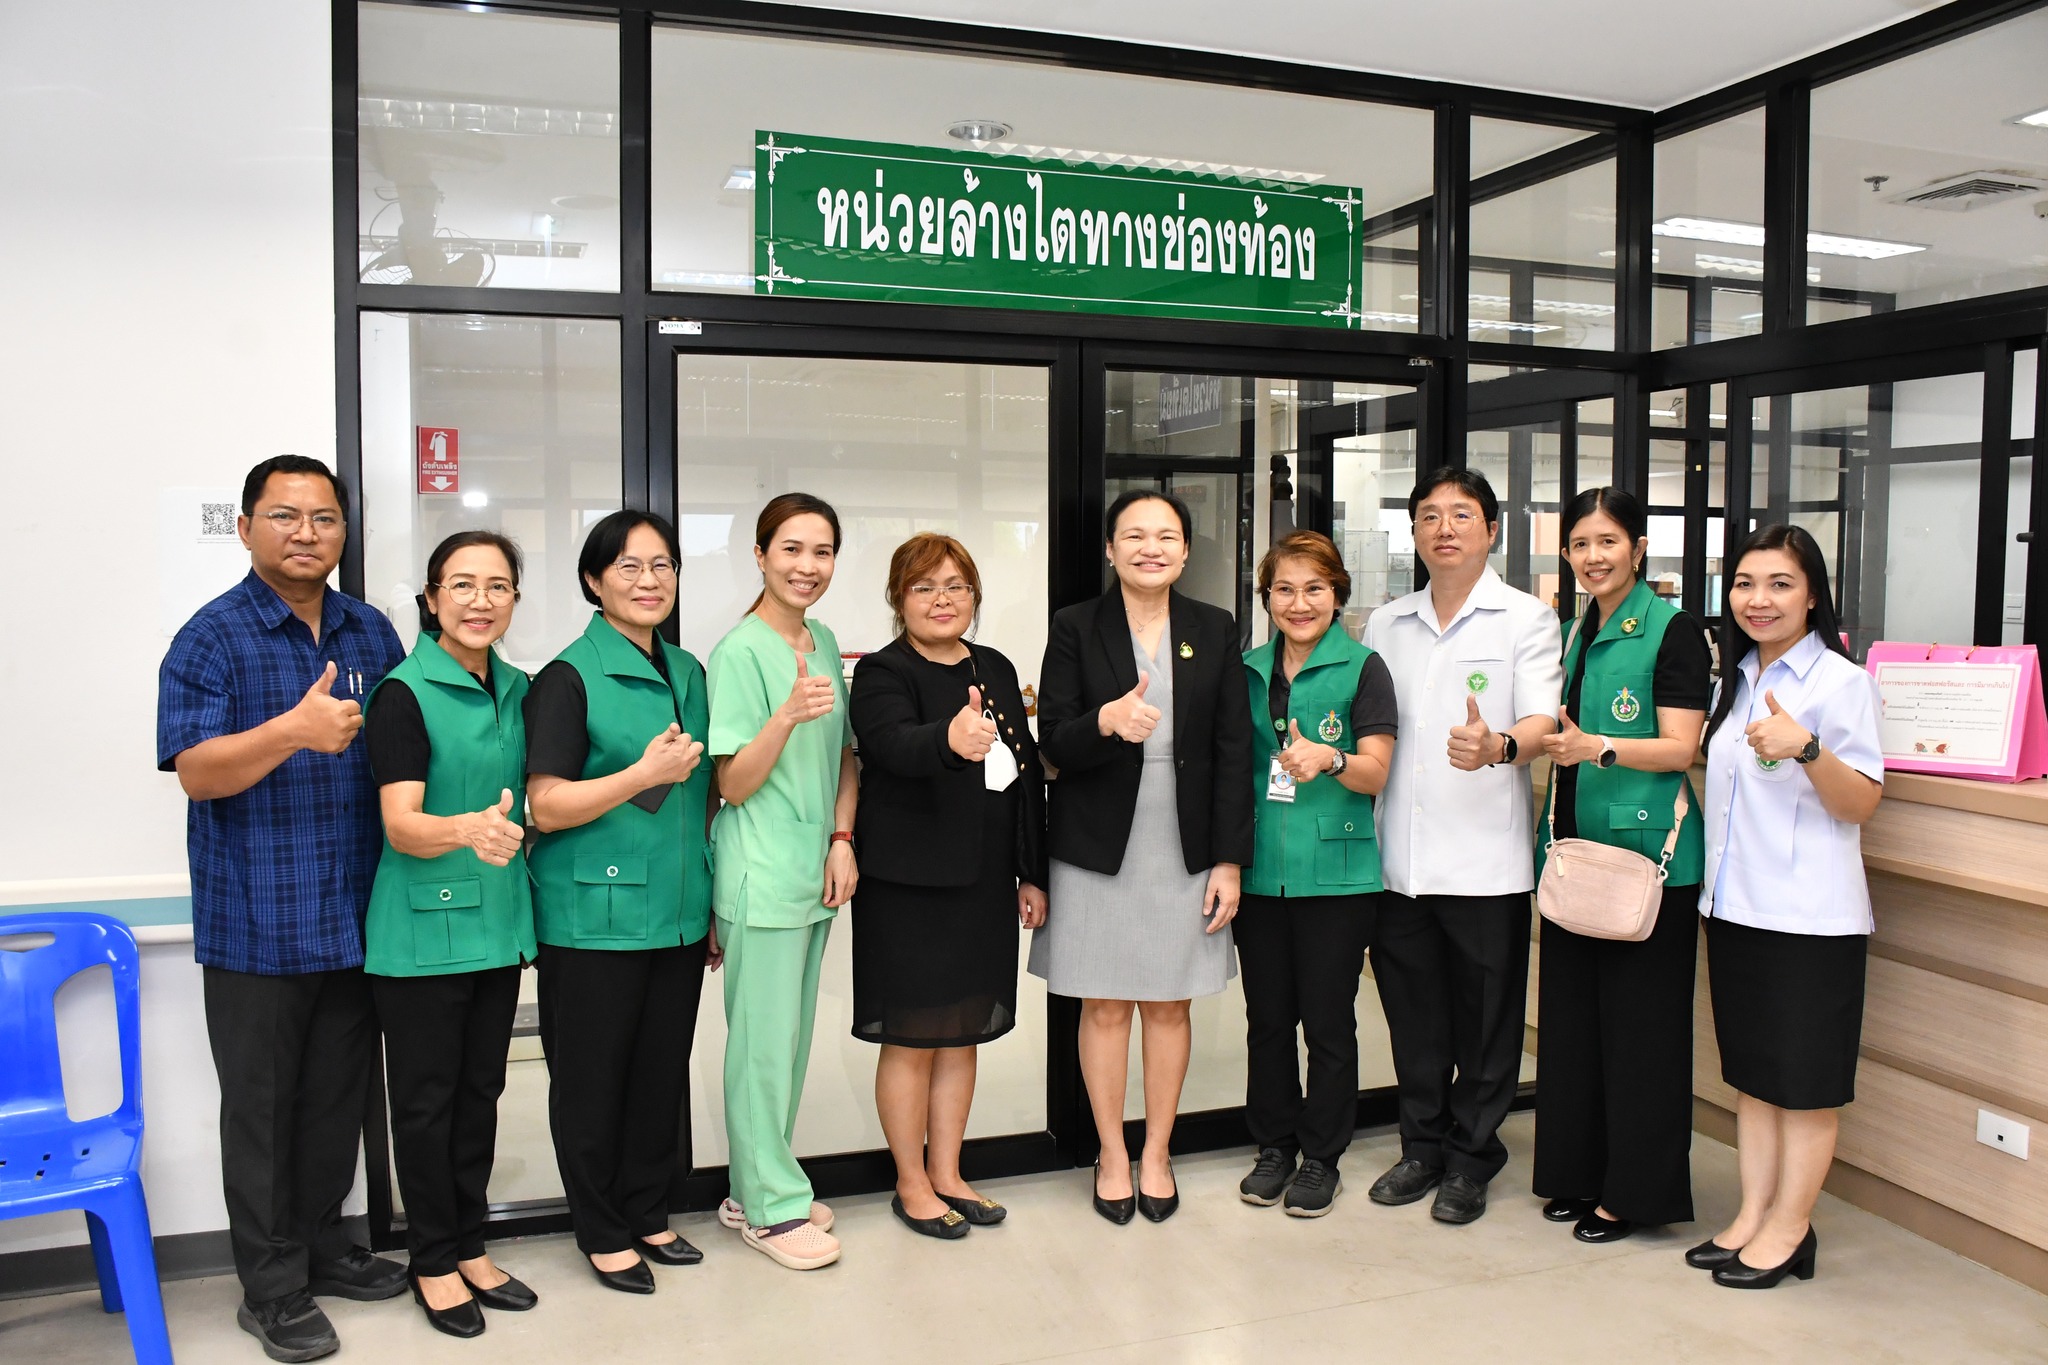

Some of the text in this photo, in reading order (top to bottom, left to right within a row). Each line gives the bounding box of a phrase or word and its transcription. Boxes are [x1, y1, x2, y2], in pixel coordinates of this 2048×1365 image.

[817, 168, 1316, 281] หน่วยล้างไตทางช่องท้อง
